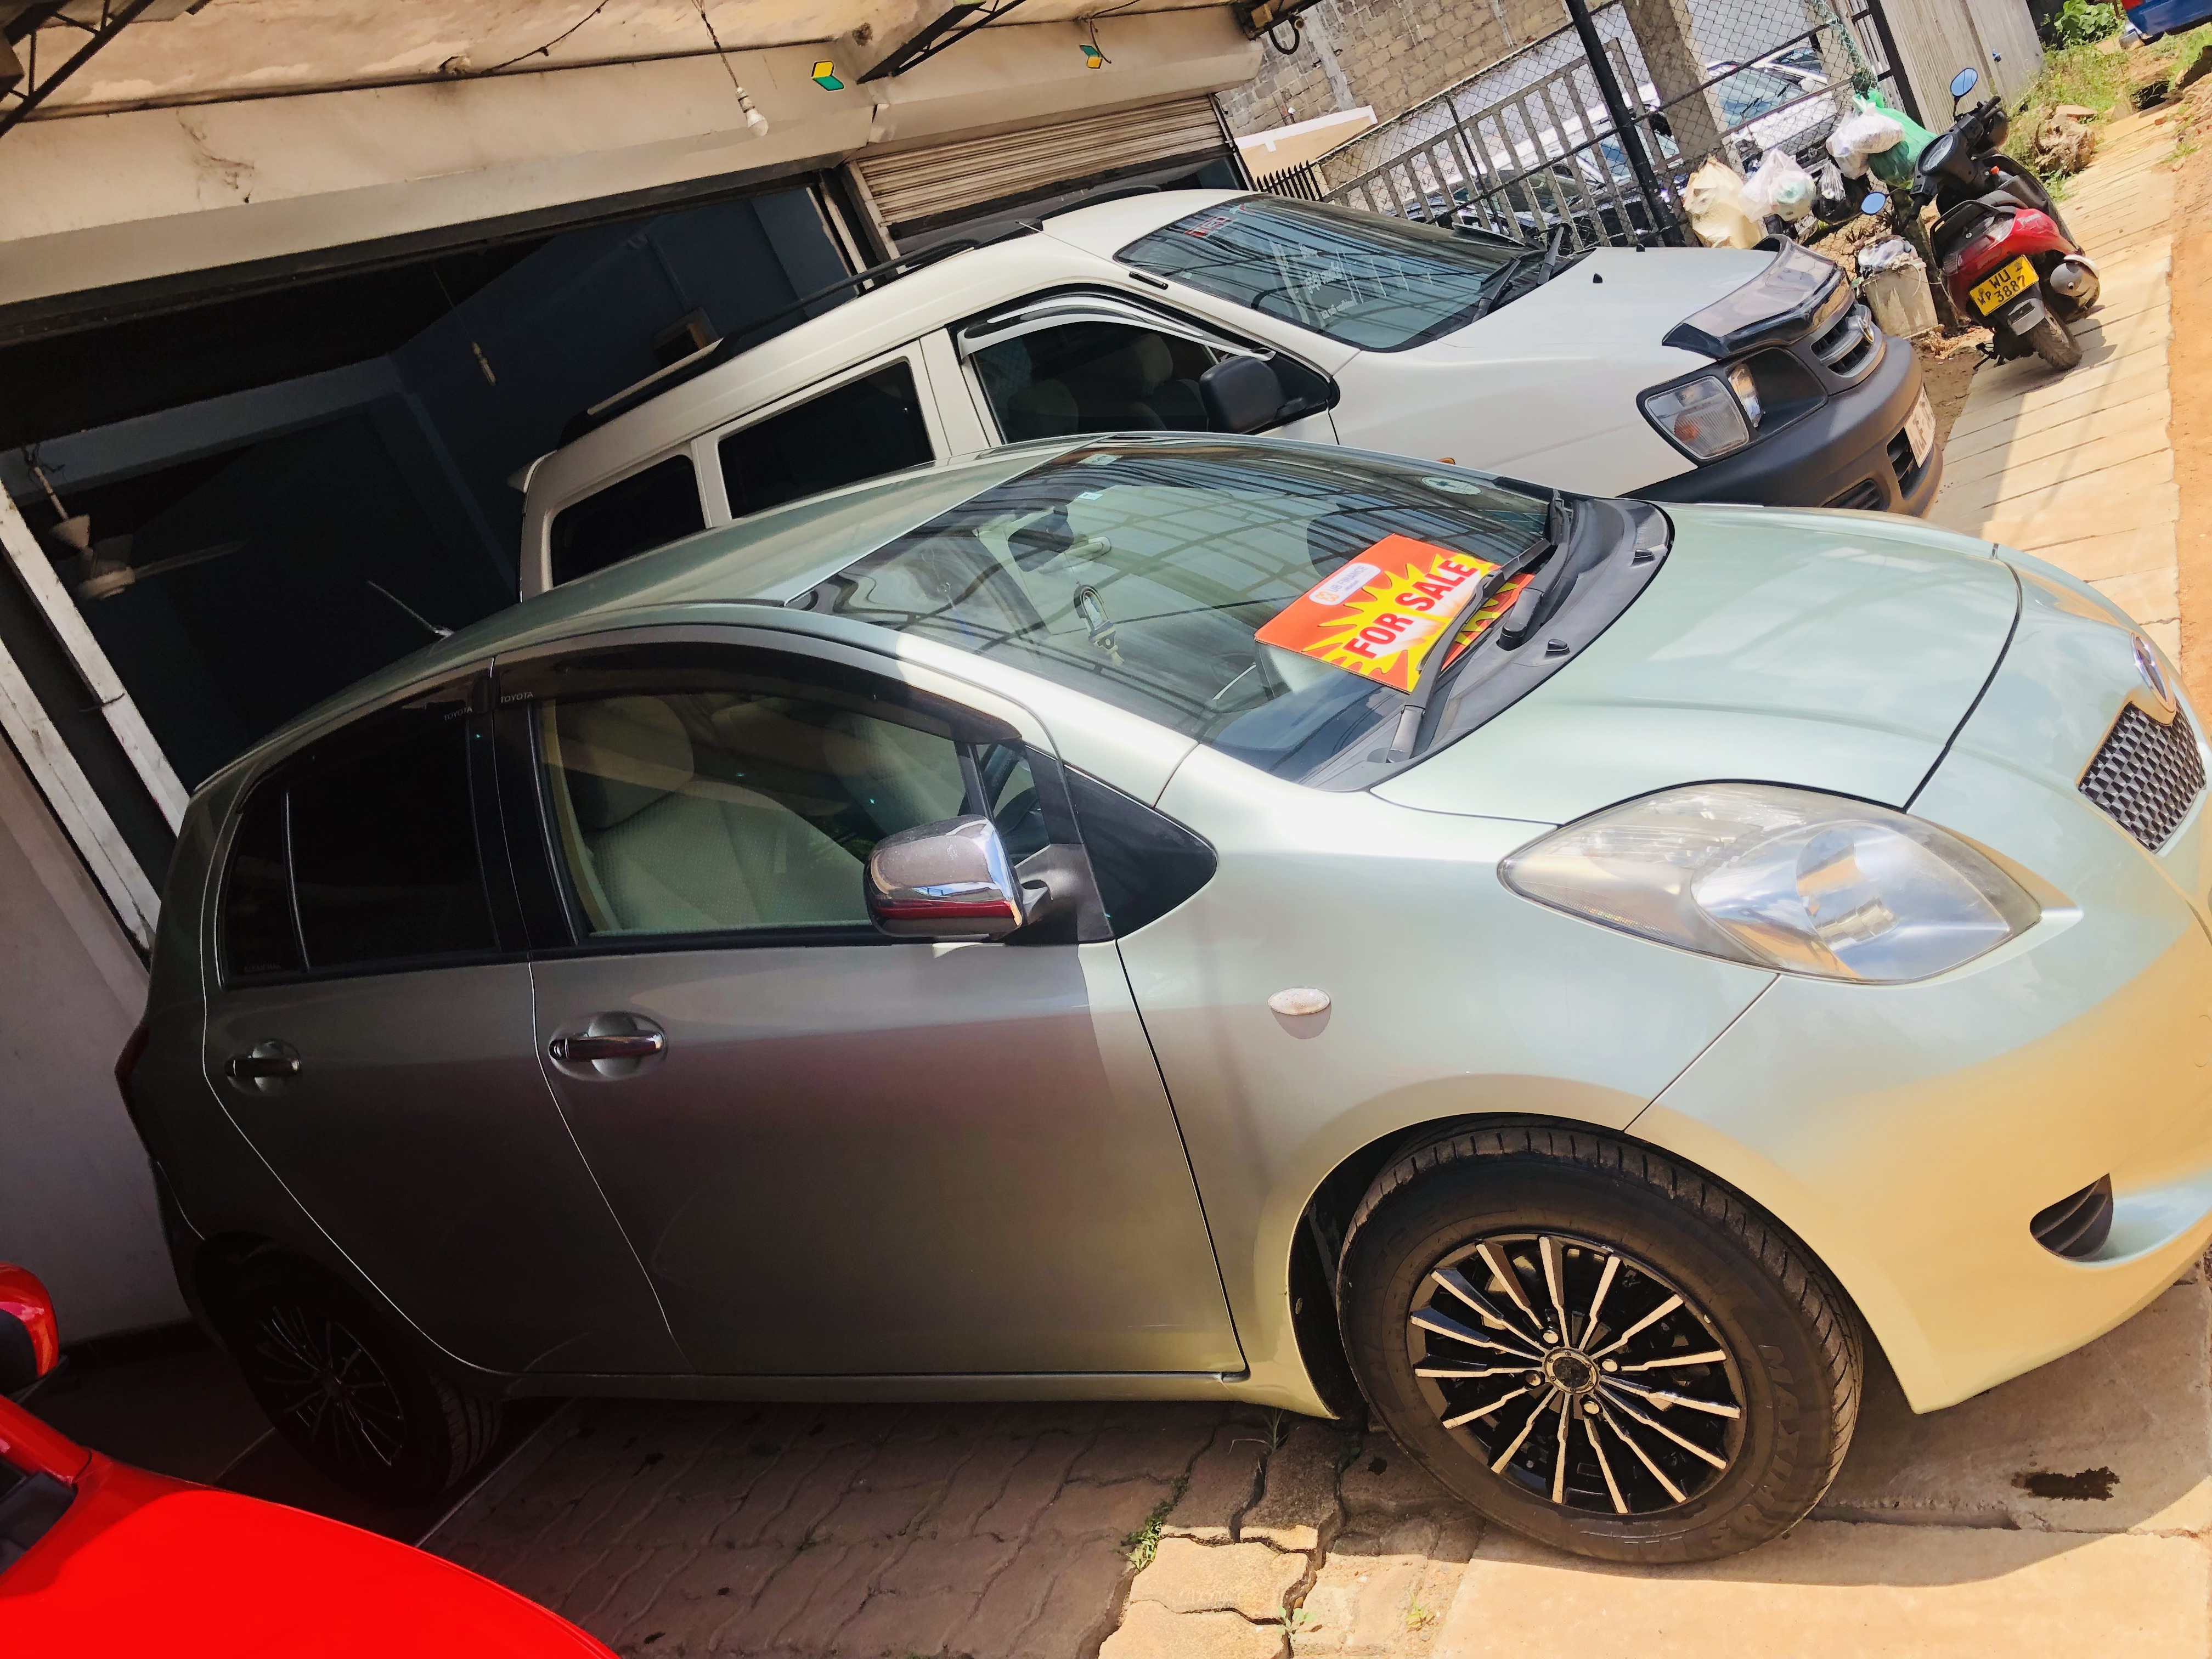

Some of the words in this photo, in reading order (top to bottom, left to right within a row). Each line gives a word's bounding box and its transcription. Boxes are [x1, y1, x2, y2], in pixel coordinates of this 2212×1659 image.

[1989, 269, 2011, 289] WU
[1994, 275, 2025, 302] 3887
[1337, 566, 1368, 586] FINANCE
[1342, 613, 1415, 659] FOR
[1395, 560, 1480, 611] SALE
[500, 691, 533, 703] TOYOTA
[444, 706, 472, 721] TOYOTA
